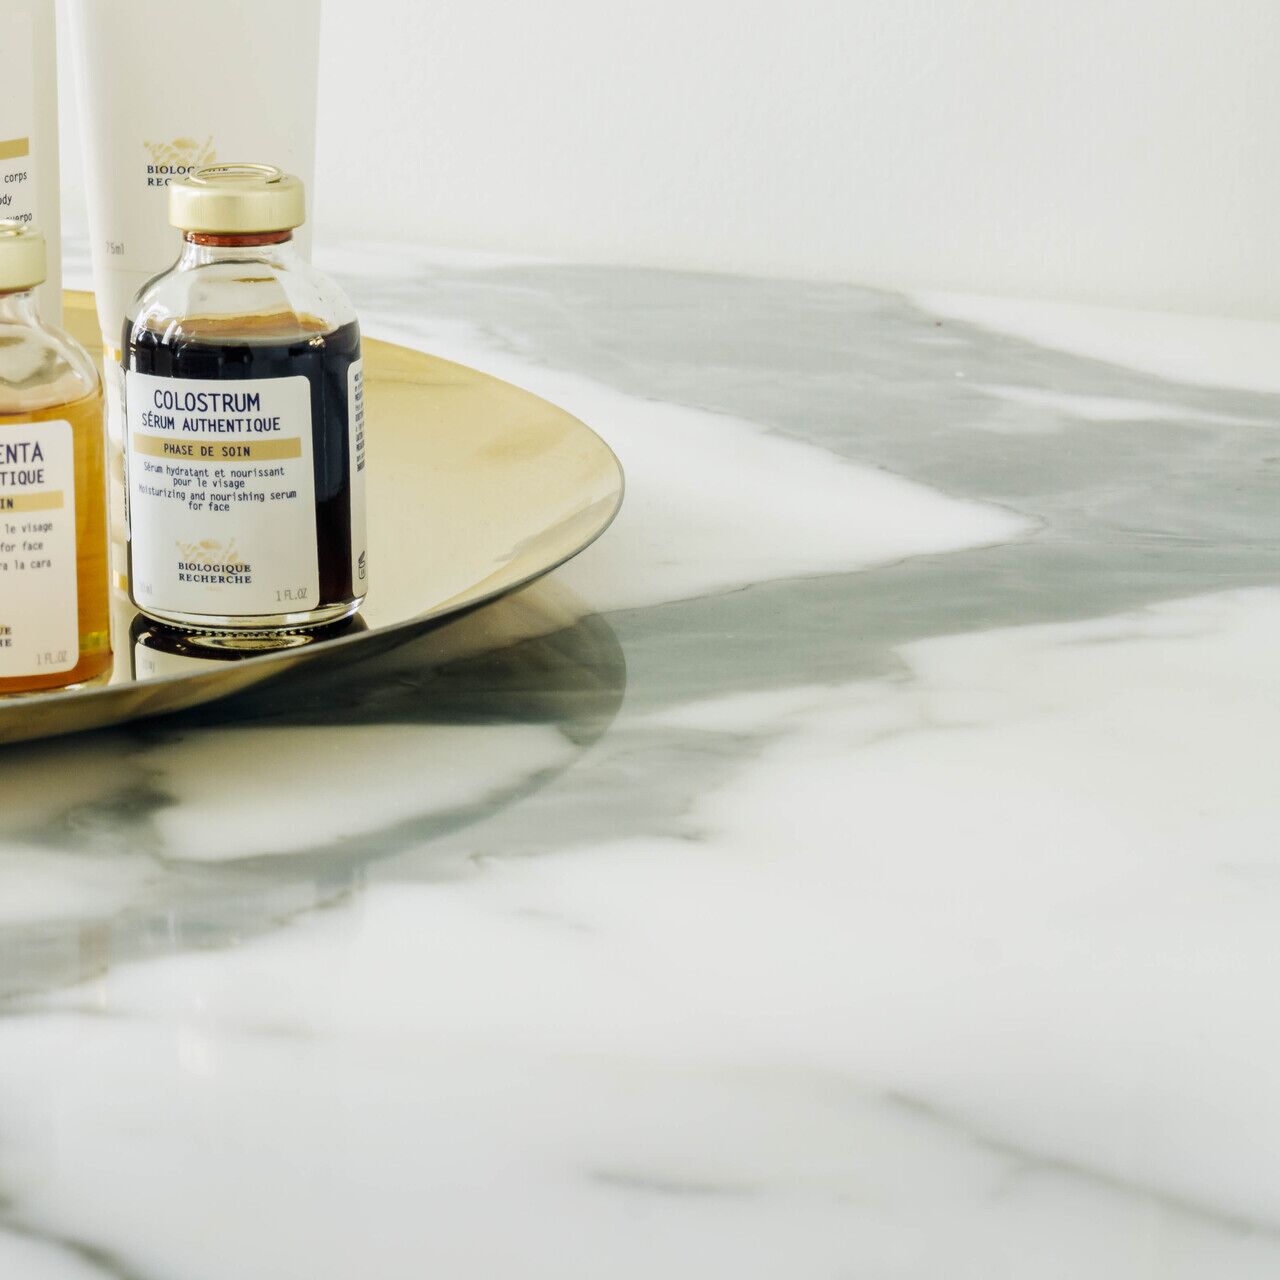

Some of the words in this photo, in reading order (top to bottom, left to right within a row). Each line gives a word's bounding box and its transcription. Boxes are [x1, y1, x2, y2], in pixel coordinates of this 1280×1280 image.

[4, 171, 28, 184] corps
[154, 389, 260, 412] COLOSTRUM
[142, 413, 174, 430] SÉRUM
[183, 417, 280, 433] AUTHENTIQUE
[164, 444, 193, 456] PHASE
[201, 446, 214, 456] DE
[222, 446, 250, 457] SOIN
[144, 462, 162, 473] Sérum
[166, 465, 209, 477] hydratant
[215, 468, 225, 478] et
[231, 467, 285, 478] nourissant
[173, 477, 191, 488] pour
[197, 478, 207, 487] le
[213, 479, 245, 489] visage
[191, 491, 205, 501] and
[210, 491, 264, 502] nourishing
[271, 490, 296, 499] serum
[189, 501, 202, 510] for
[209, 502, 229, 511] face
[178, 562, 251, 575] BIOLOGIQUE
[179, 573, 252, 584] RECHERCHE
